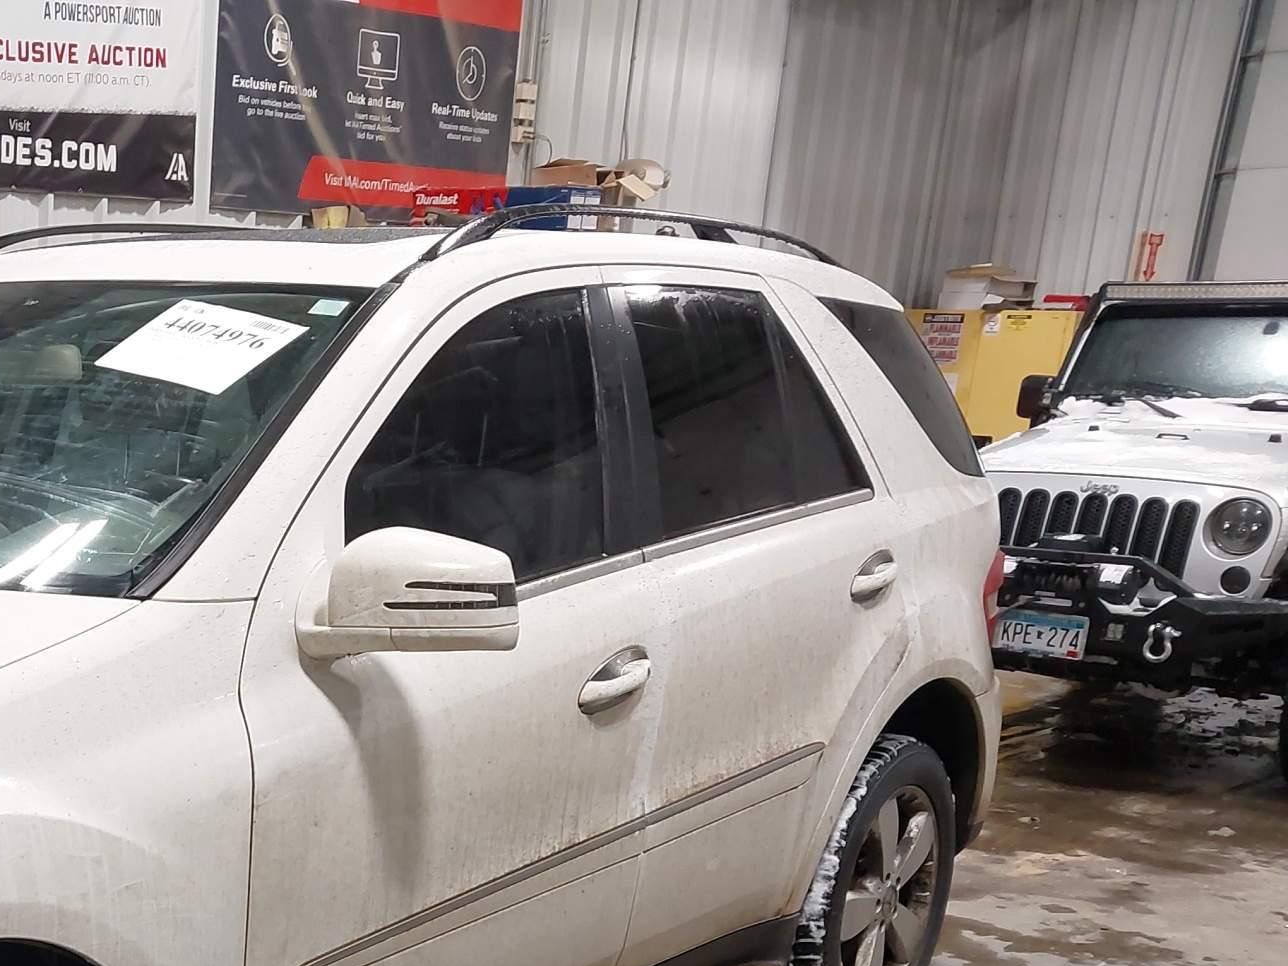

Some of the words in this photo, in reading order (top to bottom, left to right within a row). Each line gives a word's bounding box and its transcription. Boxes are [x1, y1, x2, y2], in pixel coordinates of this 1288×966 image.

[43, 1, 51, 20] A
[54, 2, 122, 24] POWERSPORT
[123, 6, 161, 27] AUCTION
[88, 44, 166, 68] AUCTION
[25, 73, 34, 82] at
[38, 73, 63, 84] noon
[67, 73, 81, 84] ET
[232, 74, 277, 92] Exclusive
[278, 80, 298, 95] First
[346, 90, 366, 106] Quick
[367, 96, 383, 107] and
[385, 97, 405, 112] Easy
[432, 102, 471, 118] Real-Time
[472, 107, 498, 122] Updates
[9, 118, 31, 132] Visit
[325, 173, 343, 187] Visit
[415, 193, 459, 205] Duralast
[164, 317, 272, 349] 44074976
[1080, 480, 1120, 496] Jeep
[1001, 621, 1035, 645] KPE
[1046, 626, 1081, 650] 274
